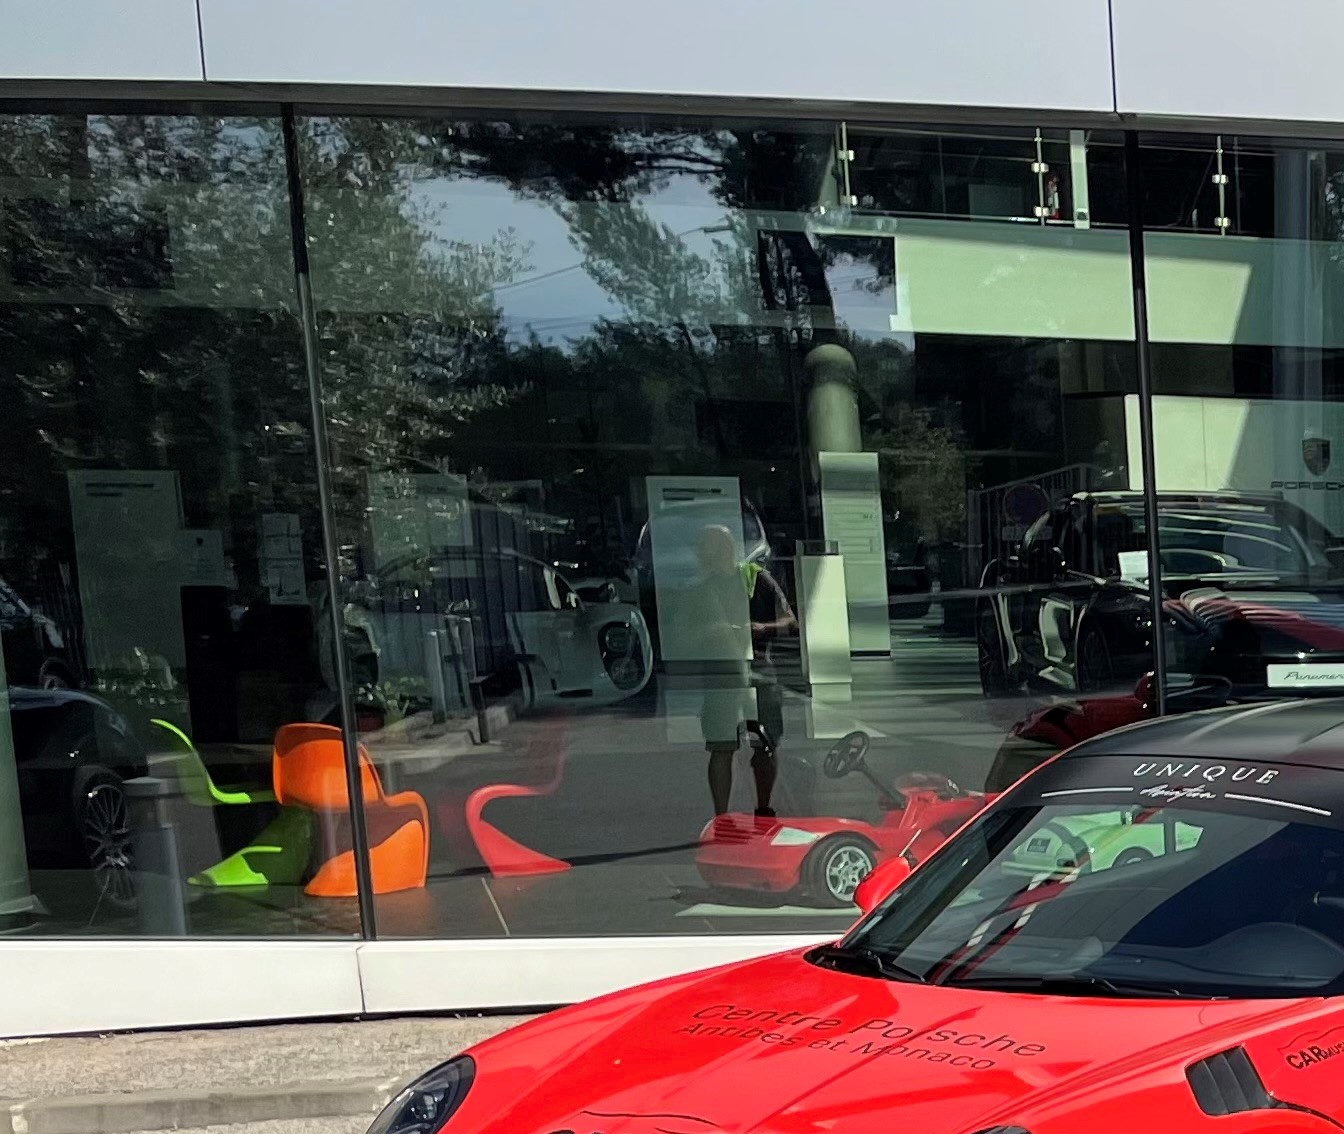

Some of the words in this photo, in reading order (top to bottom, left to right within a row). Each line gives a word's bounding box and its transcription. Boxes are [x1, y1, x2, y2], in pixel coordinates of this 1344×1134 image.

[1133, 762, 1279, 784] UNIQUE
[676, 1022, 805, 1047] Antibes
[808, 1037, 841, 1052] et
[850, 1041, 996, 1070] Monaco
[691, 1004, 842, 1032] Centre
[848, 1018, 1047, 1058] Posche
